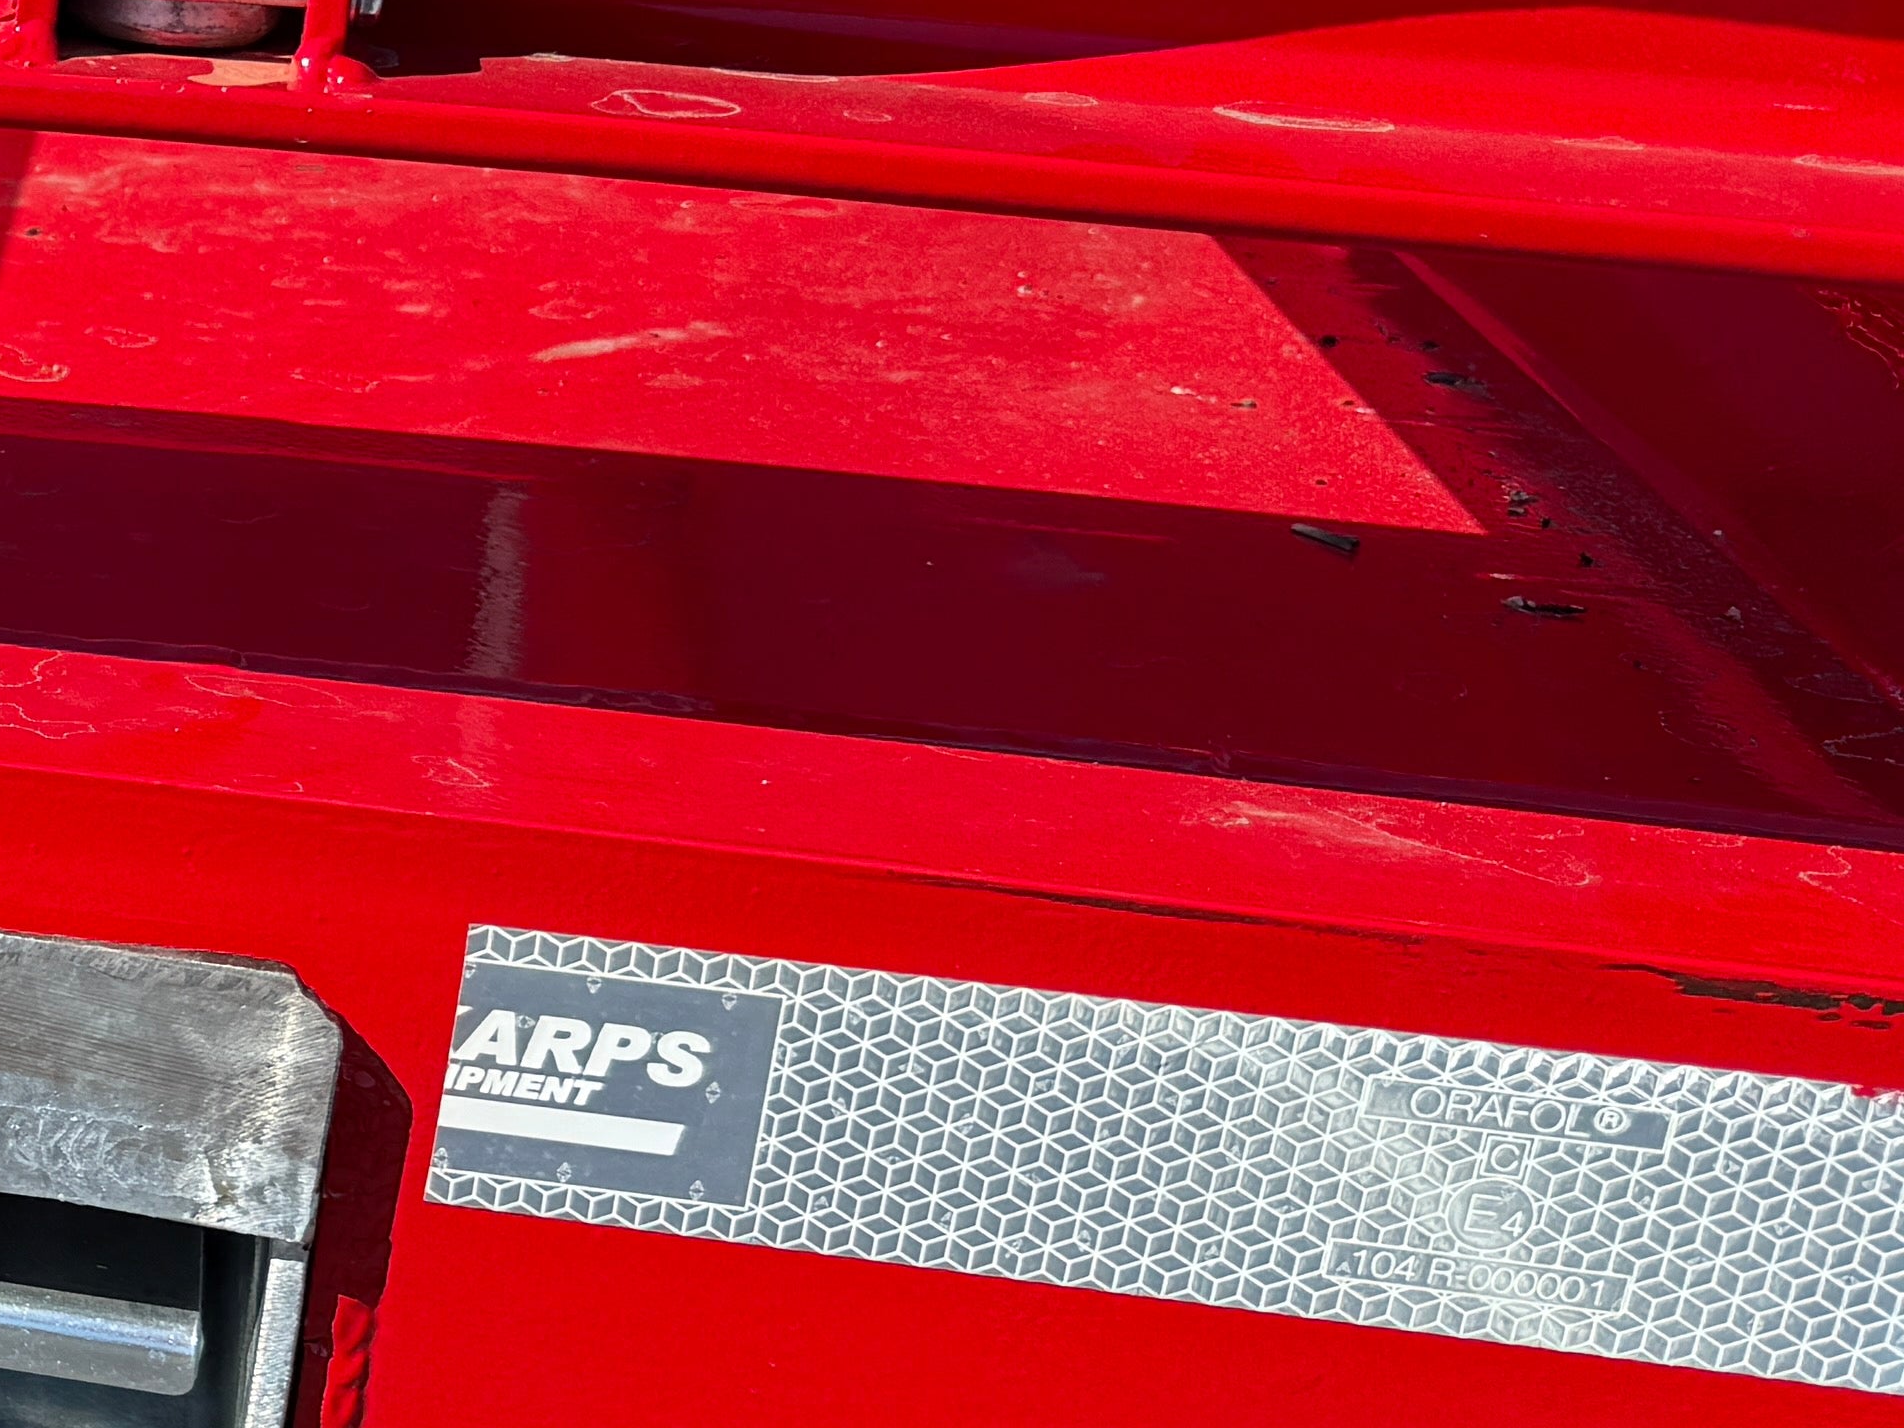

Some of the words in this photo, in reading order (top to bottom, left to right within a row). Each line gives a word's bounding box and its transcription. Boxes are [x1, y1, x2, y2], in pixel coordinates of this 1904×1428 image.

[448, 1006, 712, 1088] ARPS
[1353, 1248, 1418, 1282] 104
[1427, 1257, 1606, 1307] R-000001
